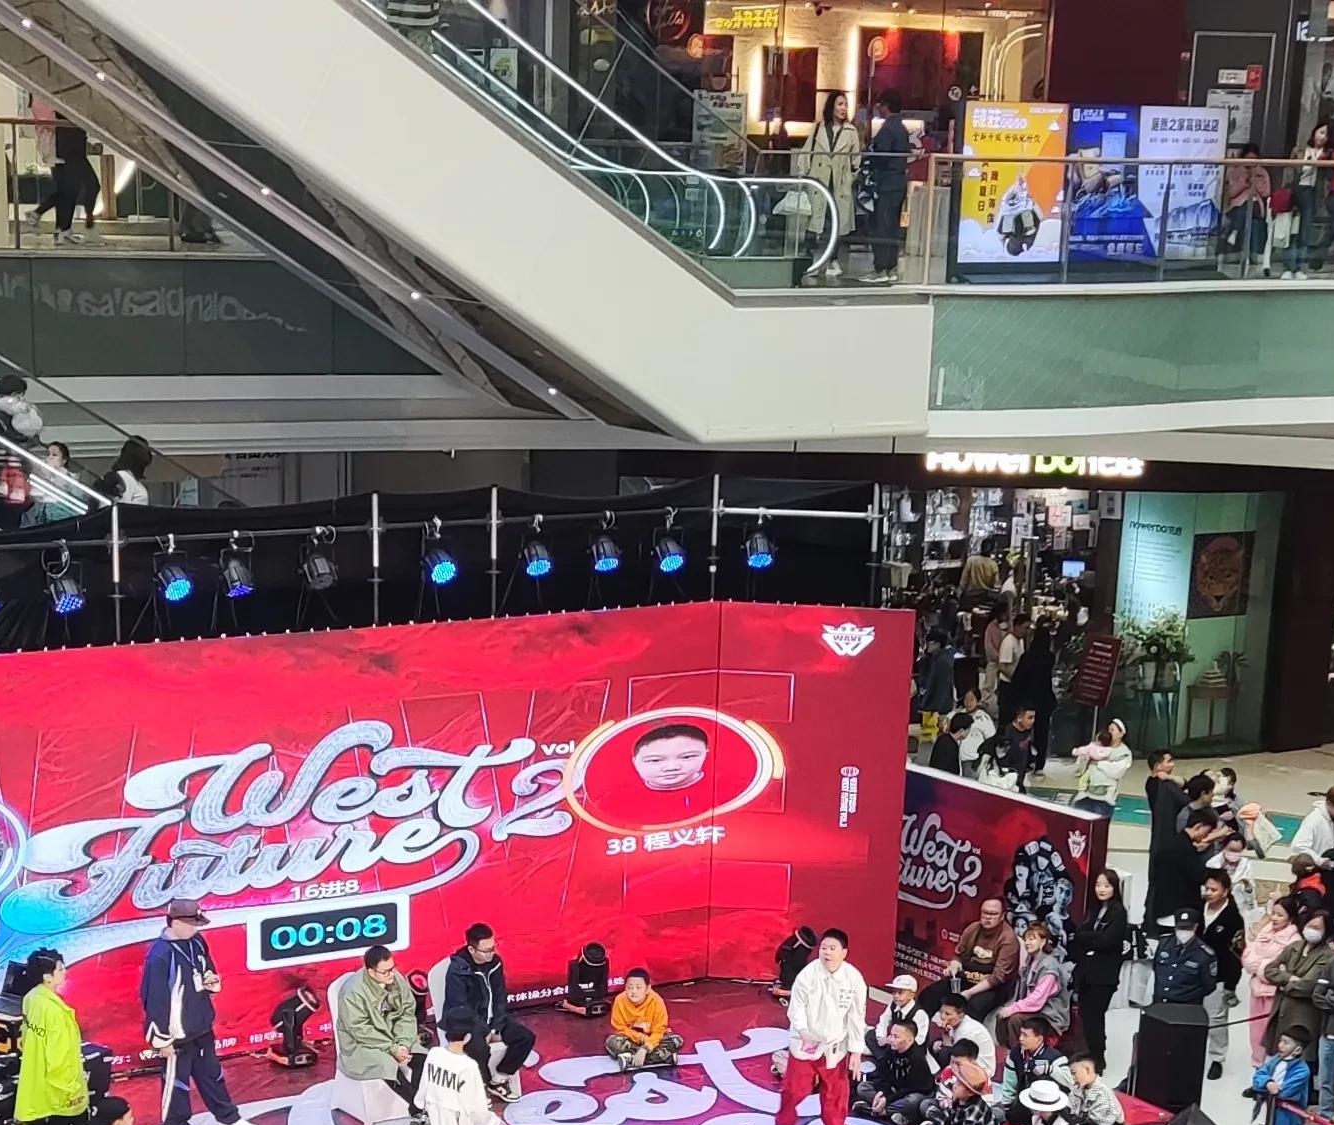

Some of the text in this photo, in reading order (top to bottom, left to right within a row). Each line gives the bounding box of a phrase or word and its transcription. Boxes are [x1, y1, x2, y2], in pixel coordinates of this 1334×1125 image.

[124, 719, 537, 835] West
[492, 757, 586, 841] 2
[605, 836, 637, 855] 38
[0, 808, 479, 934] Future
[898, 856, 956, 894] ture
[958, 854, 983, 898] 2
[269, 910, 389, 951] 00:08
